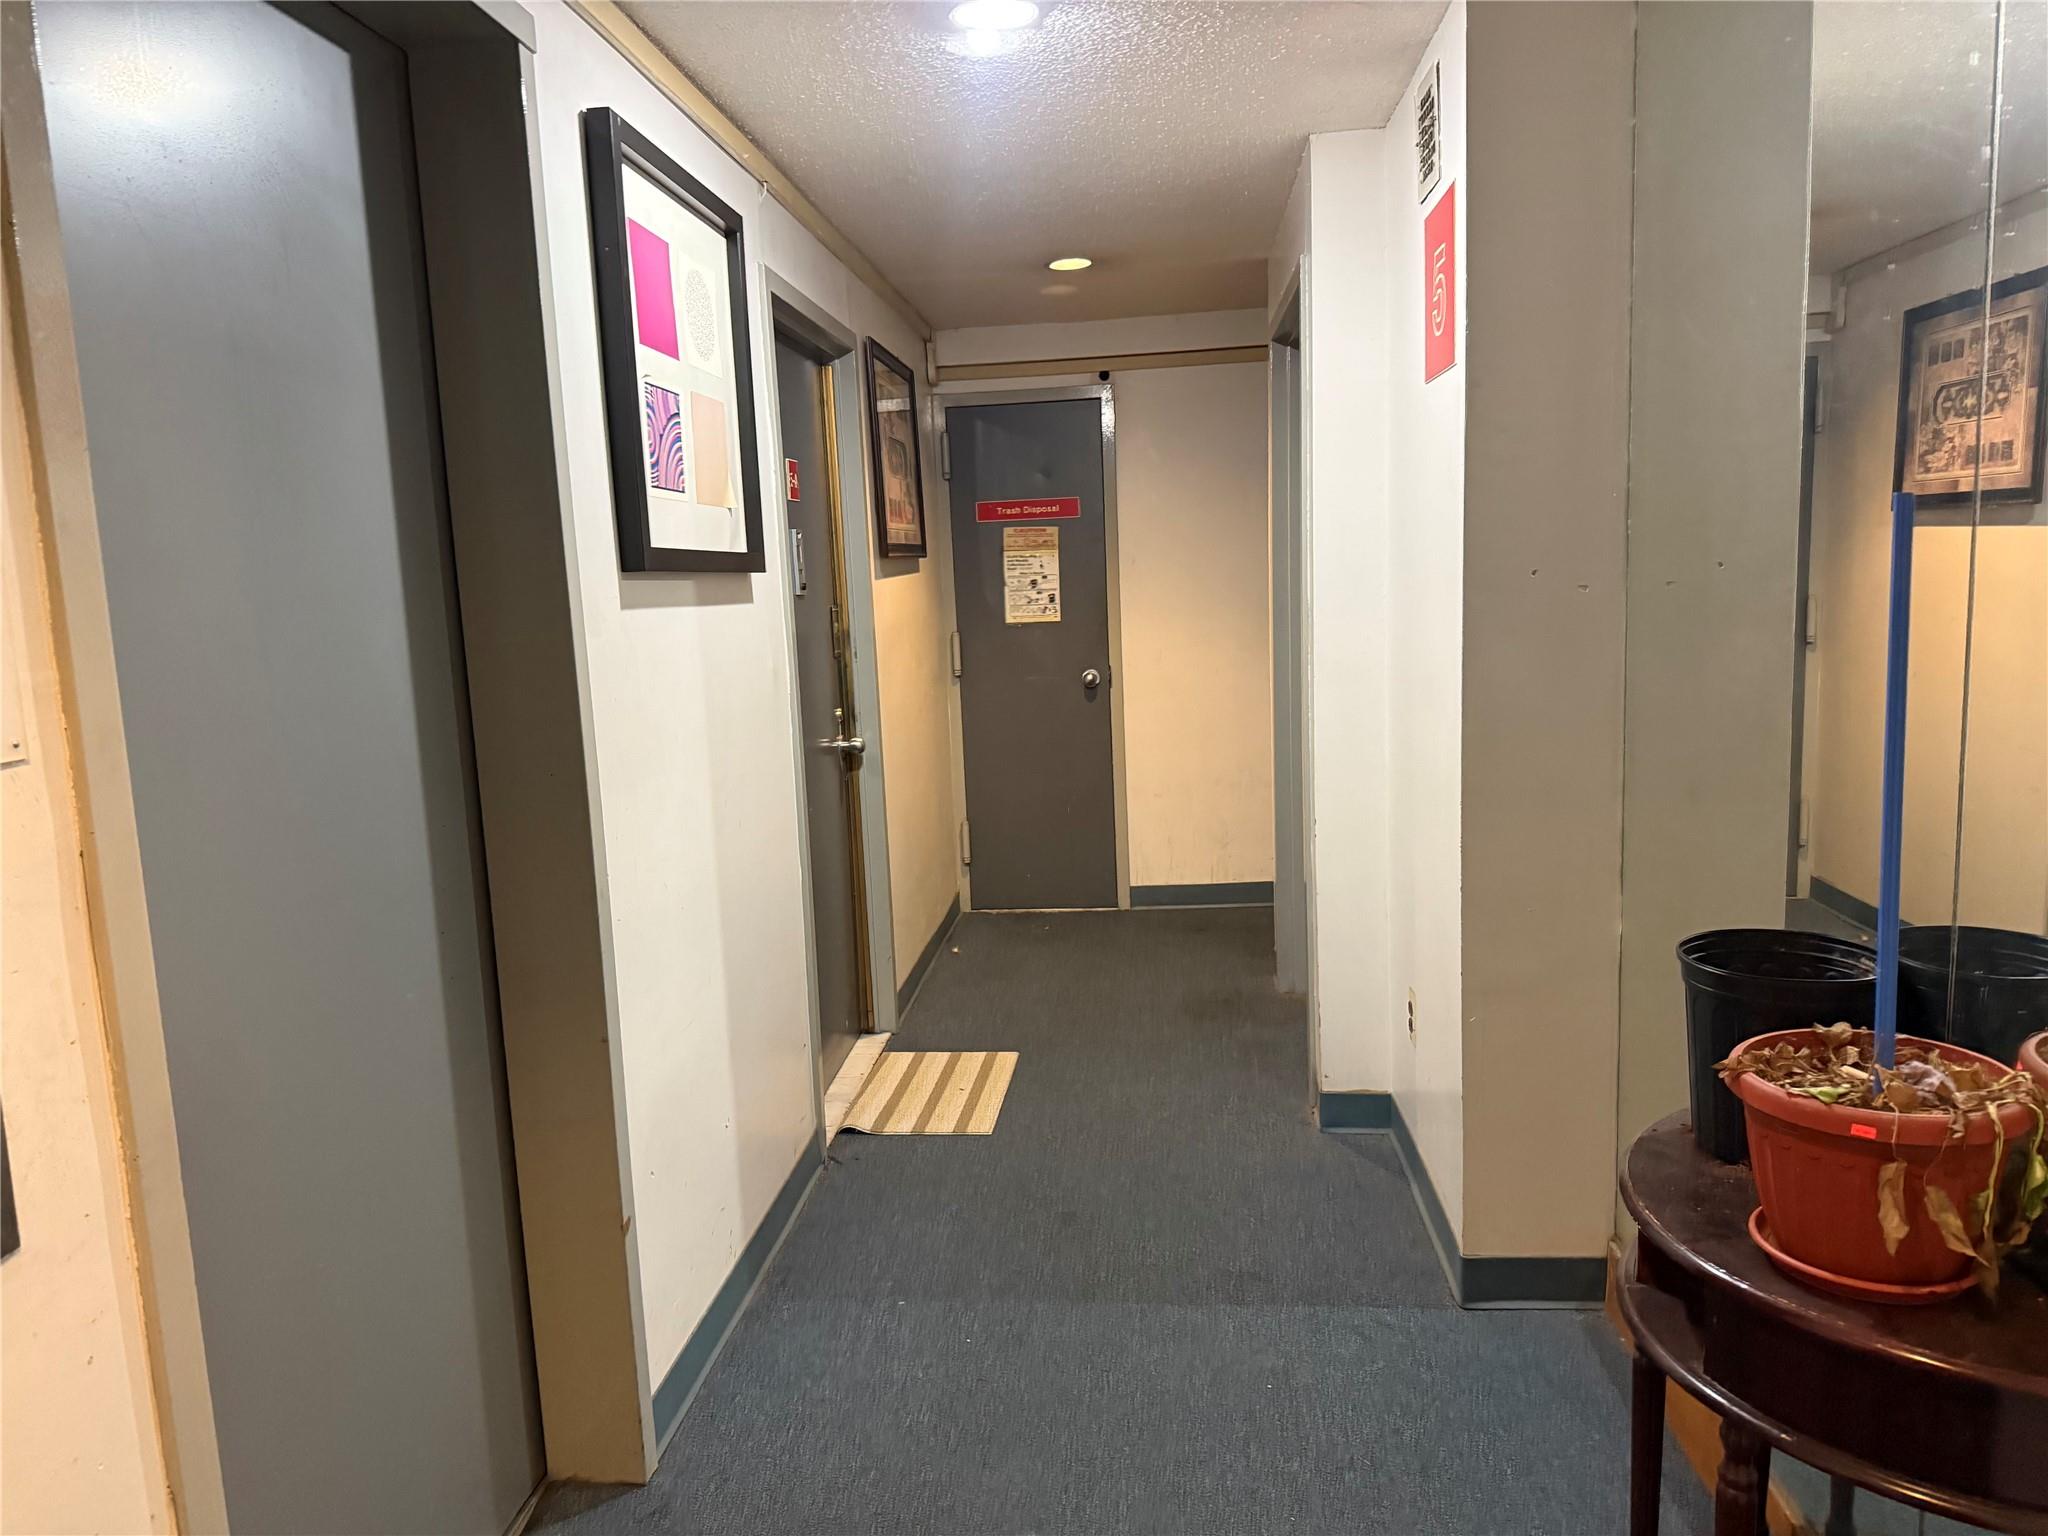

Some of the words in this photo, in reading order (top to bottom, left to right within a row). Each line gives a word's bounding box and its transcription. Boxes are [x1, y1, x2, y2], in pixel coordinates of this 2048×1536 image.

[1432, 242, 1447, 336] 5
[996, 507, 1021, 515] Trash
[1023, 504, 1060, 514] Disposal
